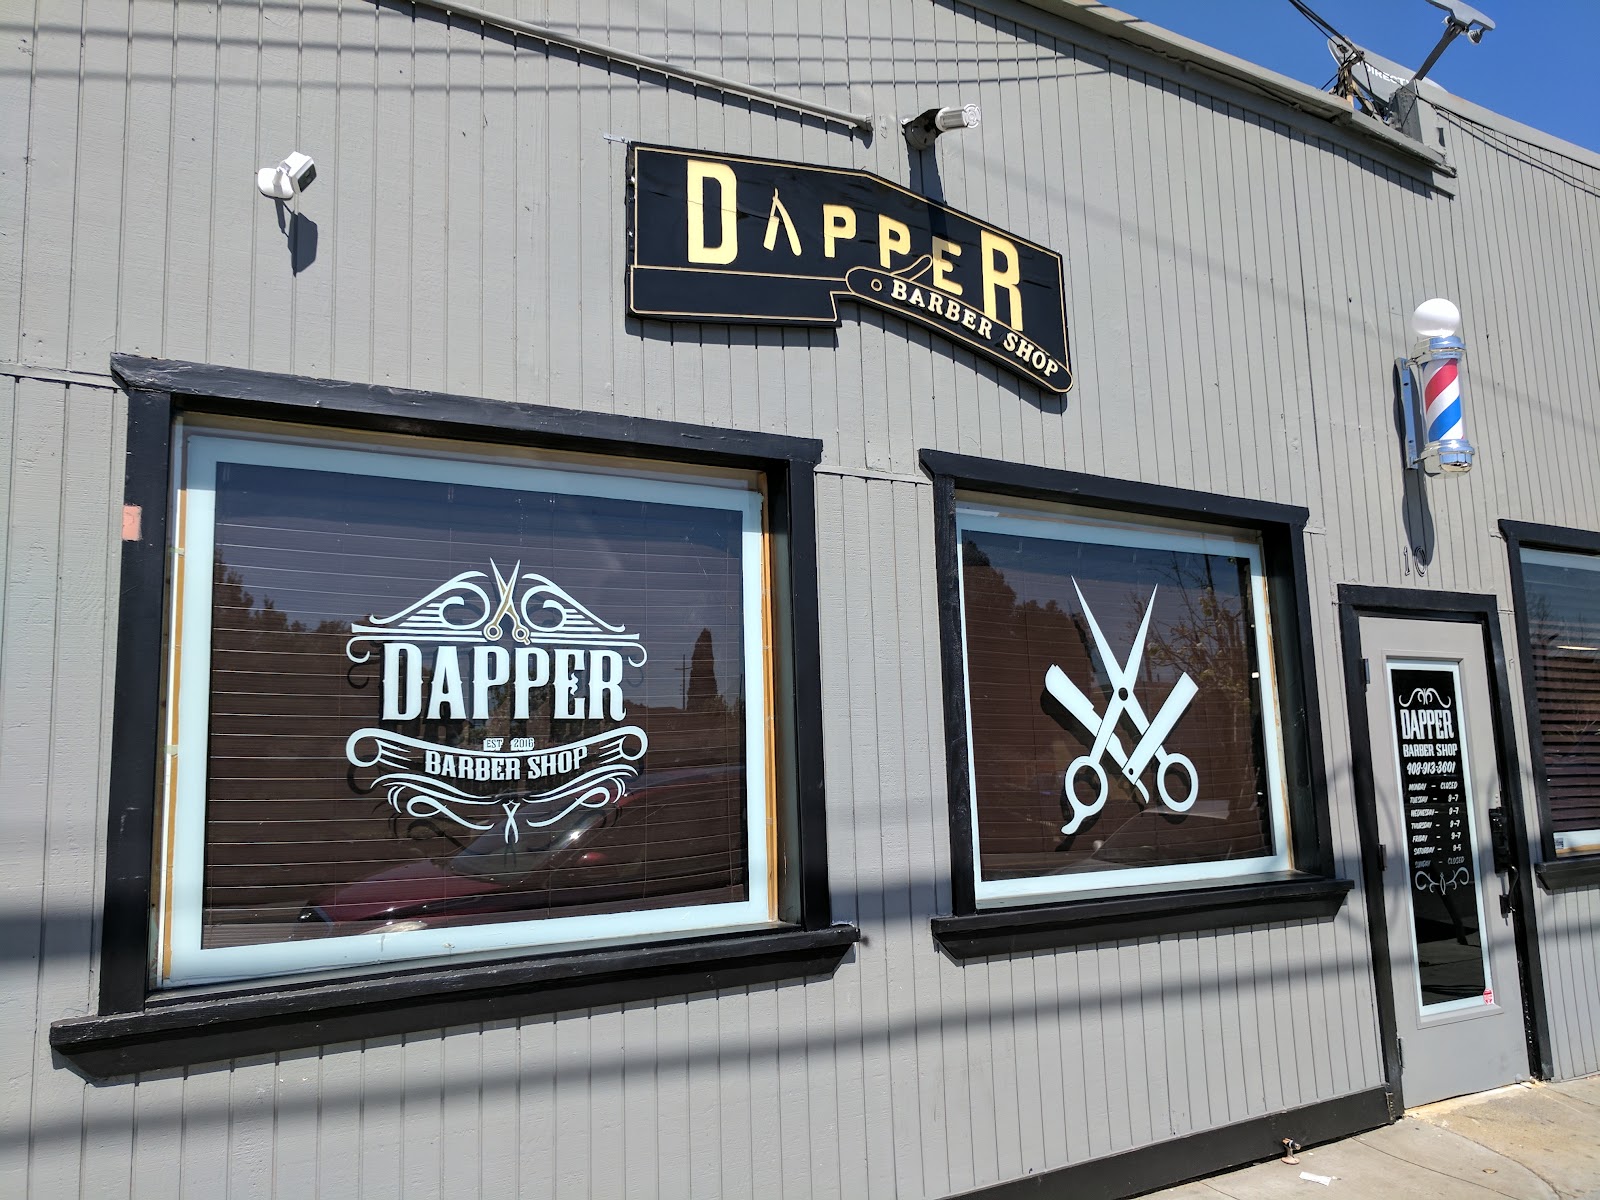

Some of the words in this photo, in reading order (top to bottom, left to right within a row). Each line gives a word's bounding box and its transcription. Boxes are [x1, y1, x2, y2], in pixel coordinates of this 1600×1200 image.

[686, 158, 1024, 332] DAPPER
[891, 279, 993, 340] BARBER
[1003, 332, 1059, 377] SHOP
[382, 642, 627, 722] DAPPER
[1400, 709, 1454, 740] DAPPER
[486, 739, 502, 748] EST
[513, 739, 533, 748] 2016
[1402, 744, 1435, 758] BARBER
[1436, 743, 1458, 757] SHOP
[424, 750, 521, 781] BARBER
[527, 746, 588, 780] SHOP
[1406, 761, 1456, 775] 408-913-3601
[1440, 781, 1458, 790] CLOSED
[1448, 856, 1465, 865] CLOSED
